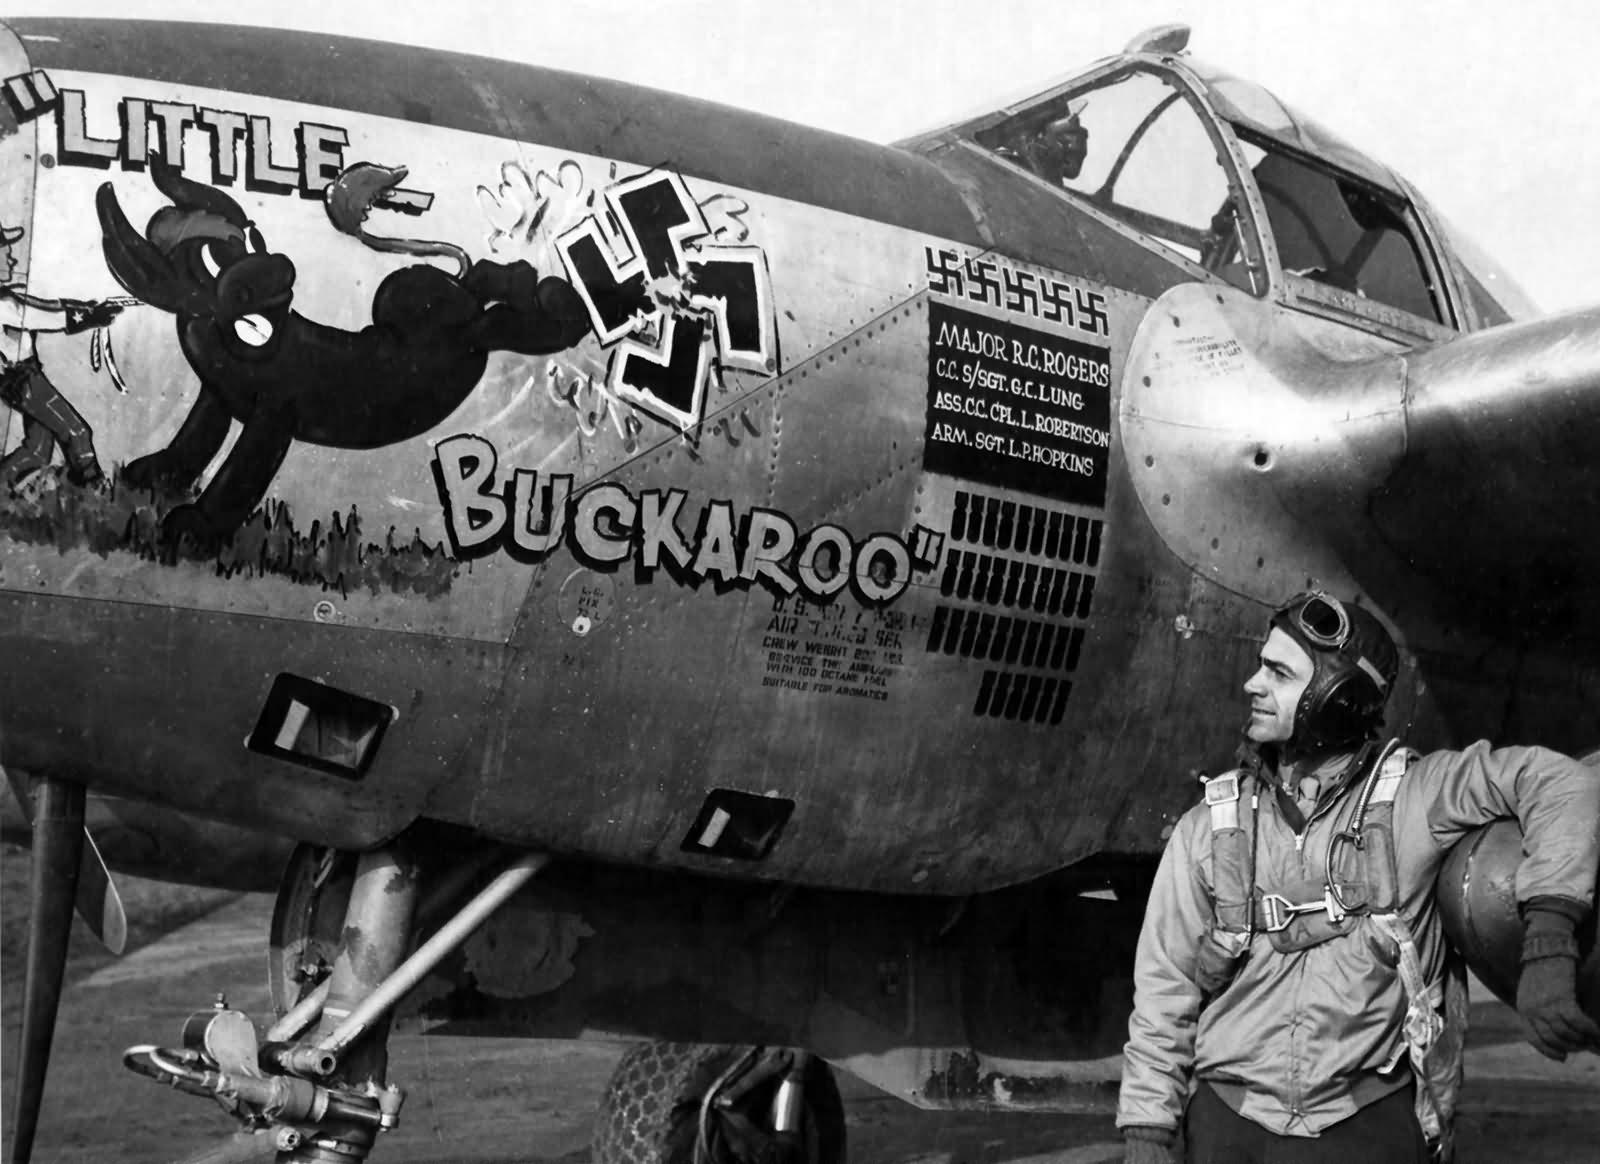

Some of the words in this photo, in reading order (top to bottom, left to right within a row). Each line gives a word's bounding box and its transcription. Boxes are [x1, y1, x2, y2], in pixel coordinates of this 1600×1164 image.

[936, 321, 1008, 361] MAJOR
[962, 361, 1009, 389] S/SGT.
[931, 422, 973, 447] ARM.
[975, 432, 1005, 455] SGT.
[767, 615, 799, 634] AIR
[762, 636, 799, 651] CREW
[762, 676, 808, 691] SUITABLE
[836, 687, 888, 701] AROMATICS
[821, 670, 858, 683] OCTANE
